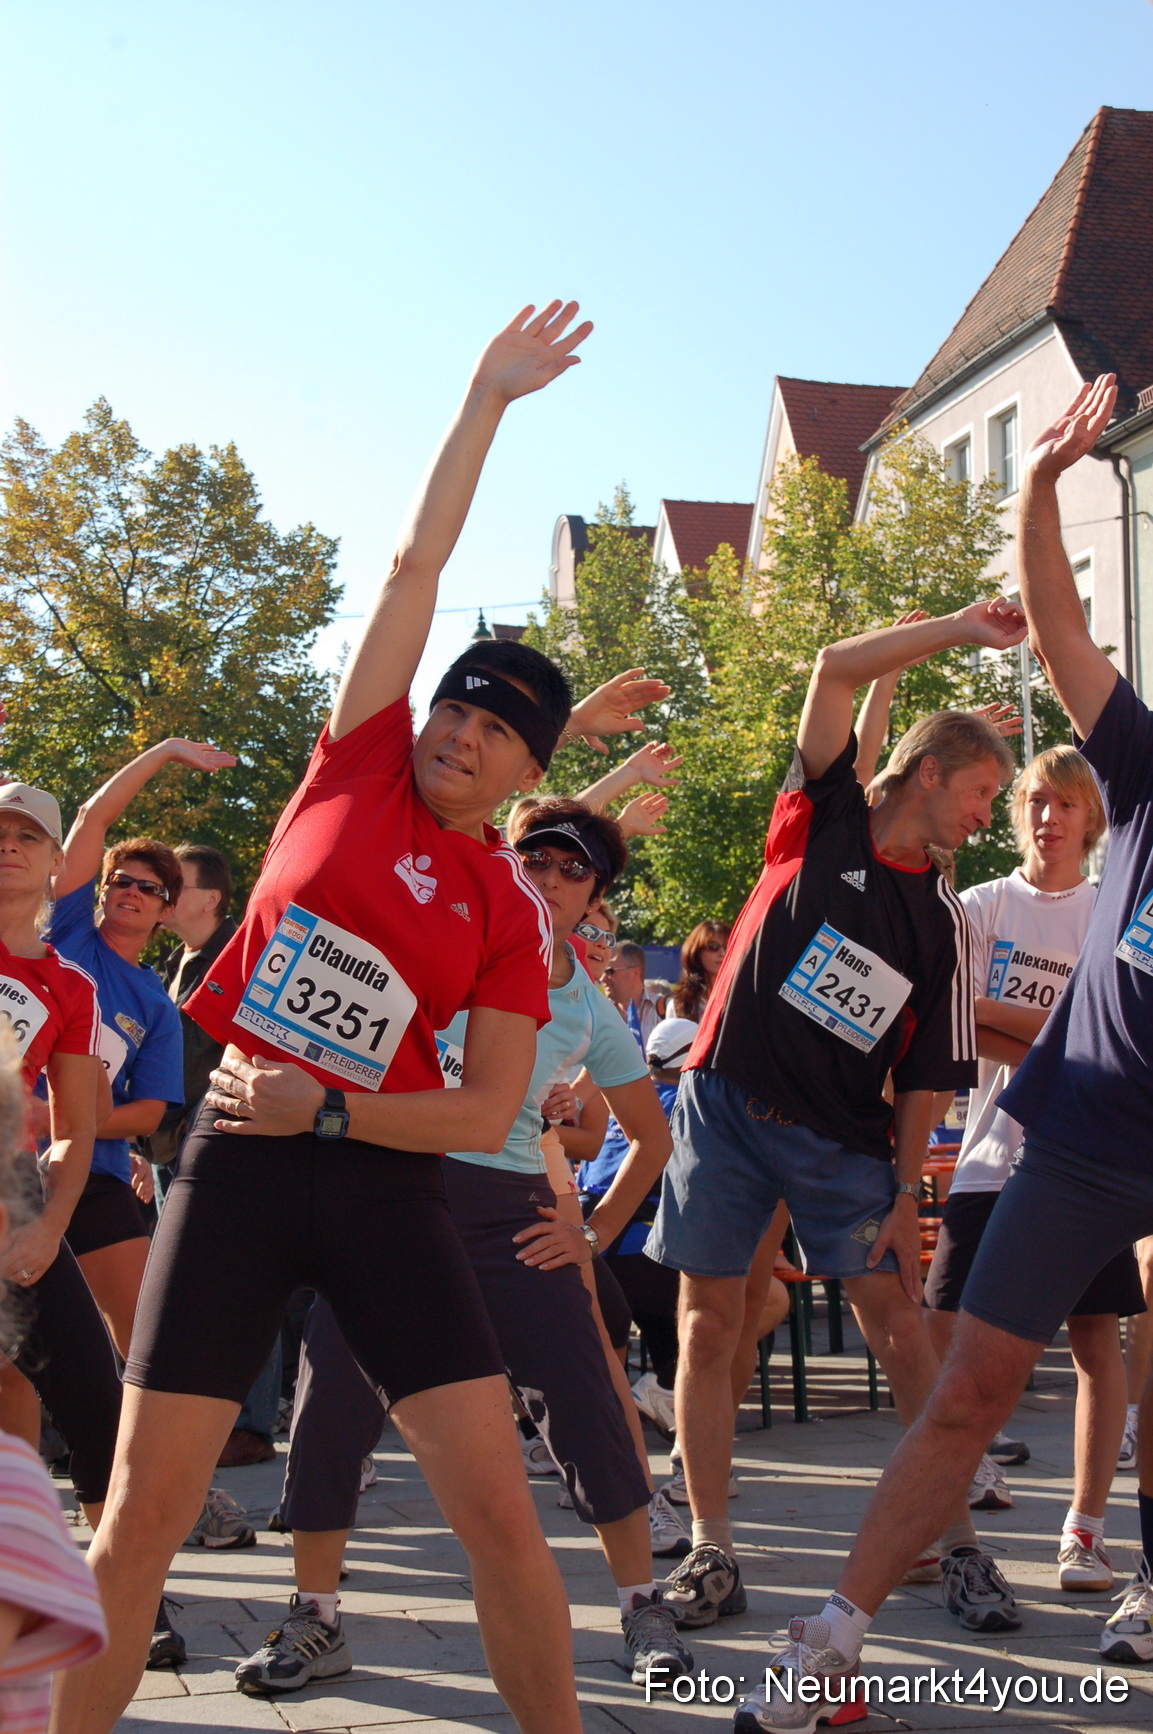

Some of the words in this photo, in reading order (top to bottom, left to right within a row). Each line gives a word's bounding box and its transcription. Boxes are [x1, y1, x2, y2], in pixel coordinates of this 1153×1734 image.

[841, 872, 866, 893] adidas
[267, 953, 286, 974] C
[308, 934, 390, 993] Claudia
[805, 955, 818, 970] A
[834, 945, 873, 978] Hans
[992, 968, 1000, 982] A
[1011, 950, 1074, 979] Alexande
[0, 983, 29, 1006] lies
[781, 985, 818, 1012] BOCK
[815, 972, 887, 1029] 2431
[1003, 976, 1063, 1009] 240
[238, 1006, 291, 1041] BOCK
[286, 977, 390, 1052] 3251
[836, 1022, 874, 1048] PFLEIDERER
[322, 1050, 383, 1082] PFLEIDERER
[442, 1054, 463, 1080] Ve
